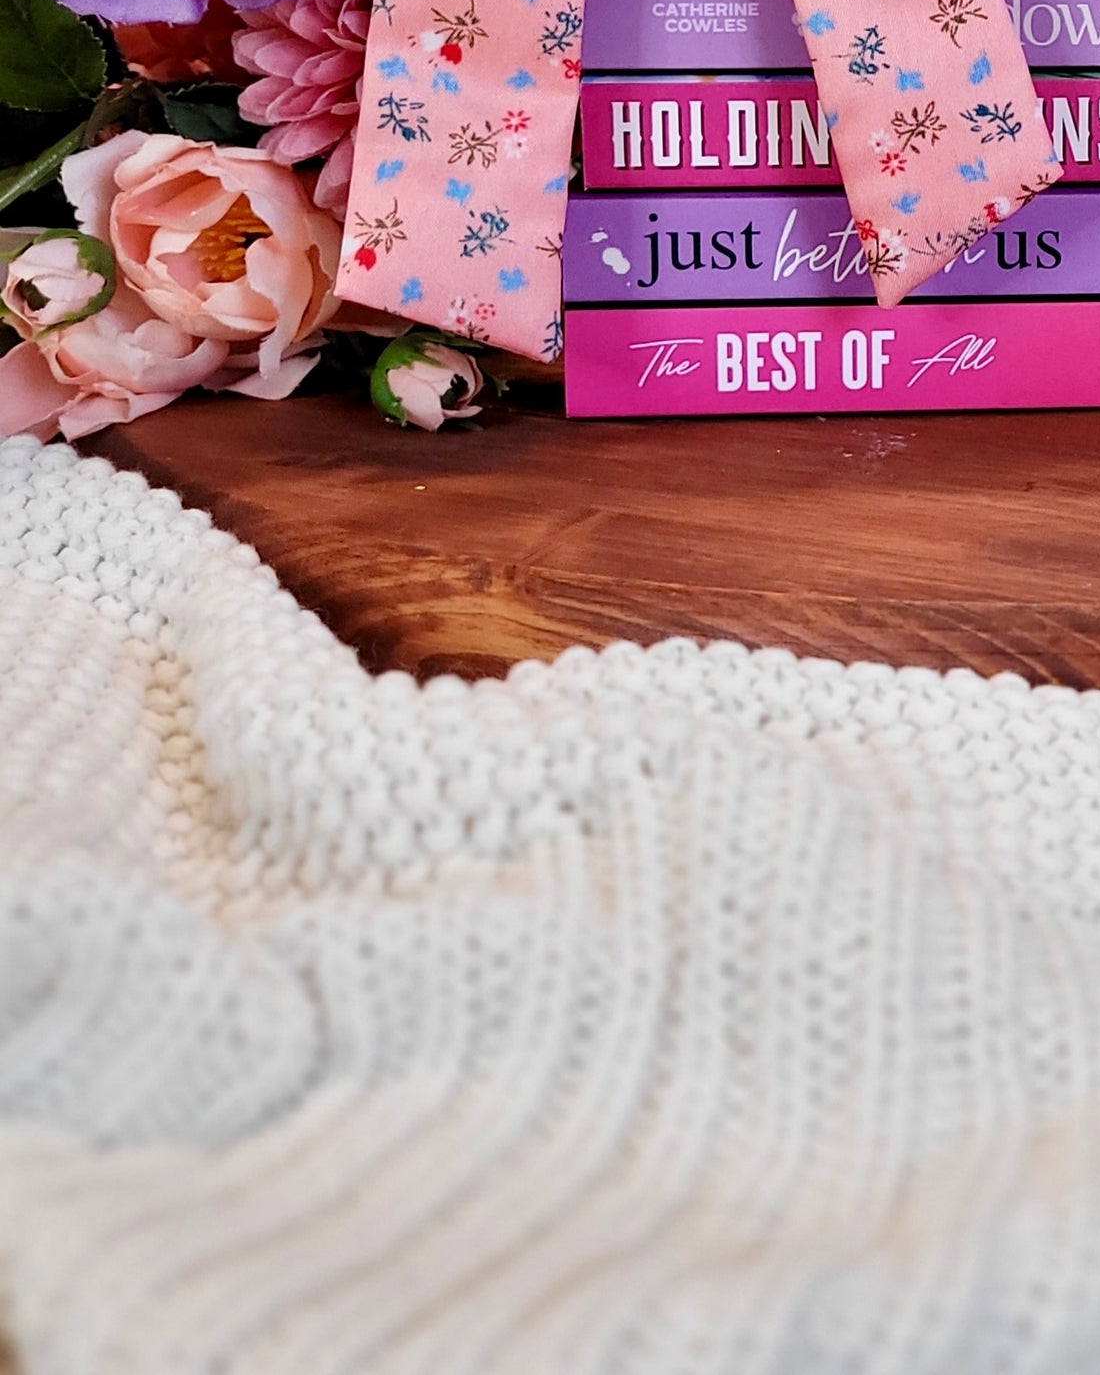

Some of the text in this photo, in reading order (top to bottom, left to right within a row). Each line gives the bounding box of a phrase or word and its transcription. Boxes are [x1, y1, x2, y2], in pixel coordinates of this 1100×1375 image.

[651, 1, 761, 17] CATHERINE
[664, 18, 749, 33] COWLES
[637, 212, 763, 288] just
[995, 227, 1063, 270] us
[629, 328, 998, 393] The BEST OF All
